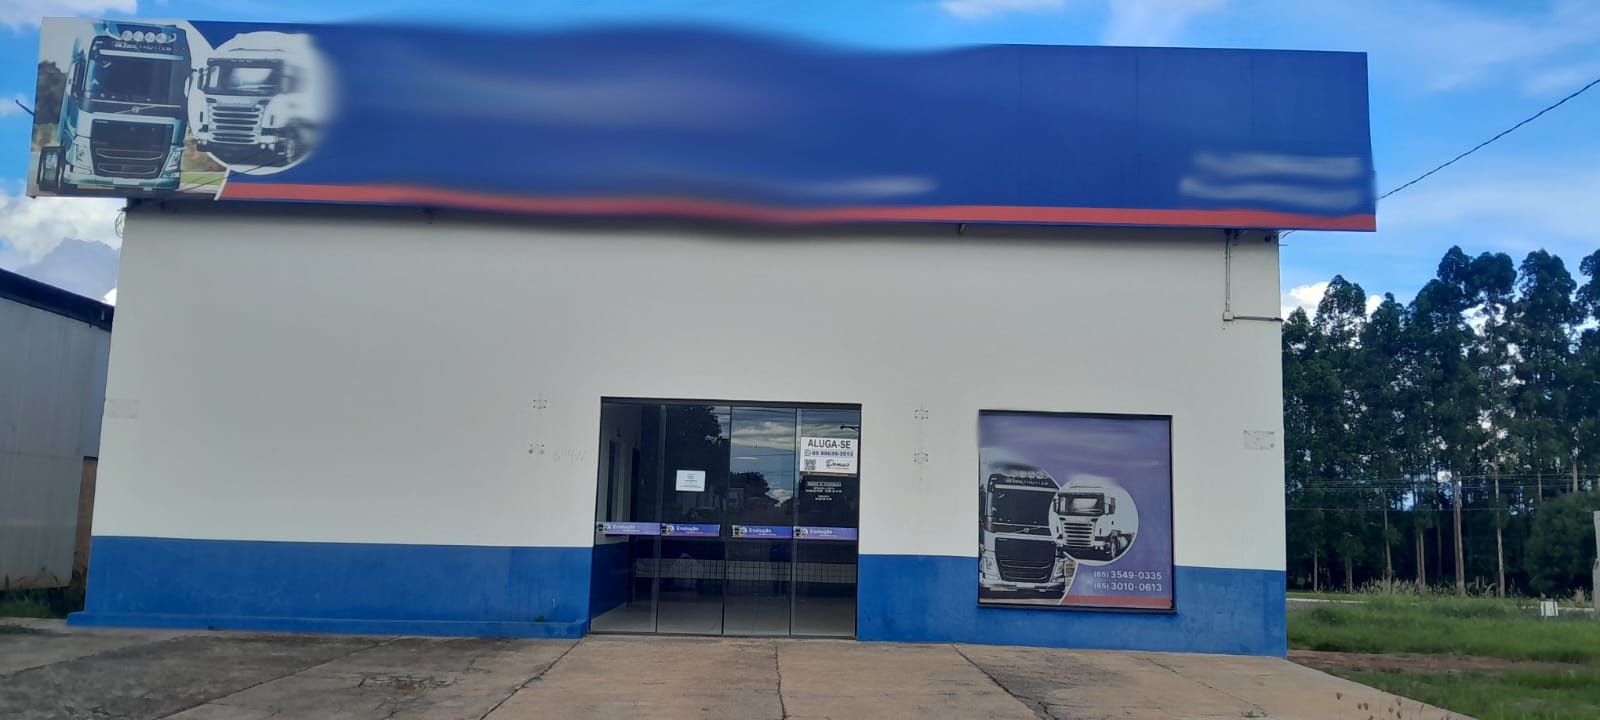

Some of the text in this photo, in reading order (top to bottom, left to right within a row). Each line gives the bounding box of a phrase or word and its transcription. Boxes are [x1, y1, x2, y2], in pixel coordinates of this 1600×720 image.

[808, 439, 852, 449] ALUGA-SE
[1110, 570, 1162, 580] 3549-0335
[1110, 582, 1162, 592] 3010-0613
